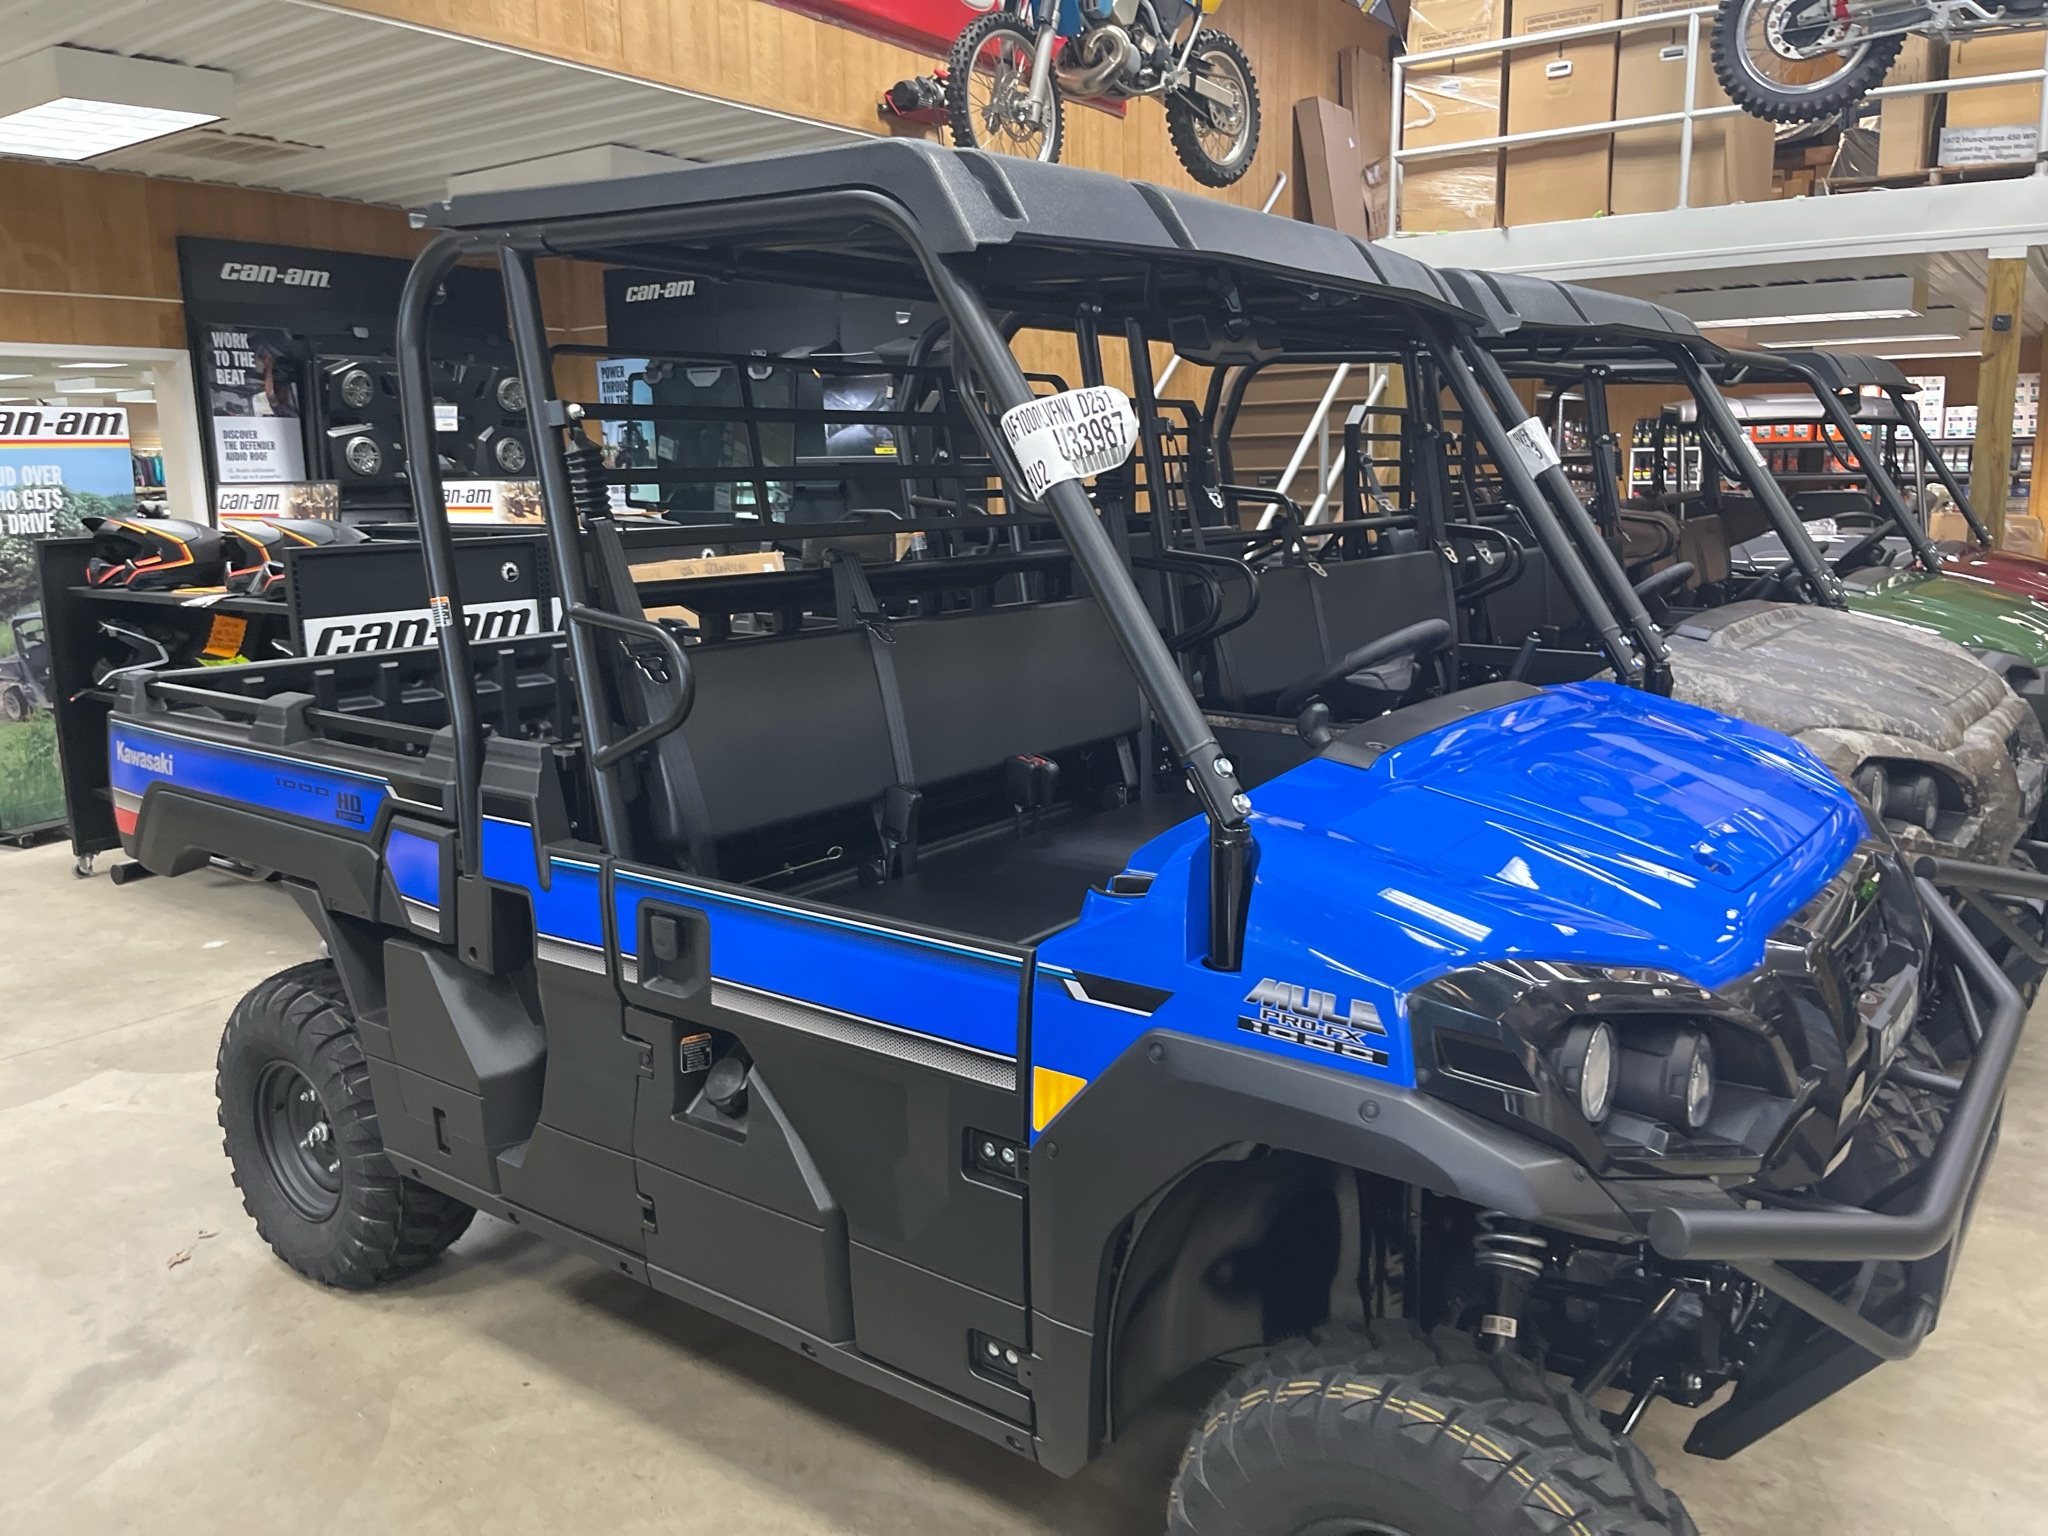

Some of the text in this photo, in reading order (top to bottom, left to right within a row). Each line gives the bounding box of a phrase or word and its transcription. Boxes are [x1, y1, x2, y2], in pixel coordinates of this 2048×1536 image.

[220, 262, 331, 288] can-am
[625, 280, 696, 303] can-am
[211, 331, 250, 349] WORK
[213, 350, 257, 368] TO THE
[215, 368, 246, 386] BEAT
[601, 365, 625, 379] POWER
[222, 429, 258, 440] DISCOVER
[223, 440, 277, 451] THE DEFENDER
[1052, 411, 1127, 461] U33987
[225, 451, 268, 462] AUDIO ROOF
[21, 464, 63, 486] OVER
[22, 488, 64, 510] GETS
[220, 493, 280, 510] can-am
[7, 511, 56, 535] DRIVE
[116, 740, 174, 776] Kawasaki
[275, 777, 362, 813] 1000 HD
[1243, 977, 1388, 1037] MULE
[1251, 1019, 1375, 1062] 1000
